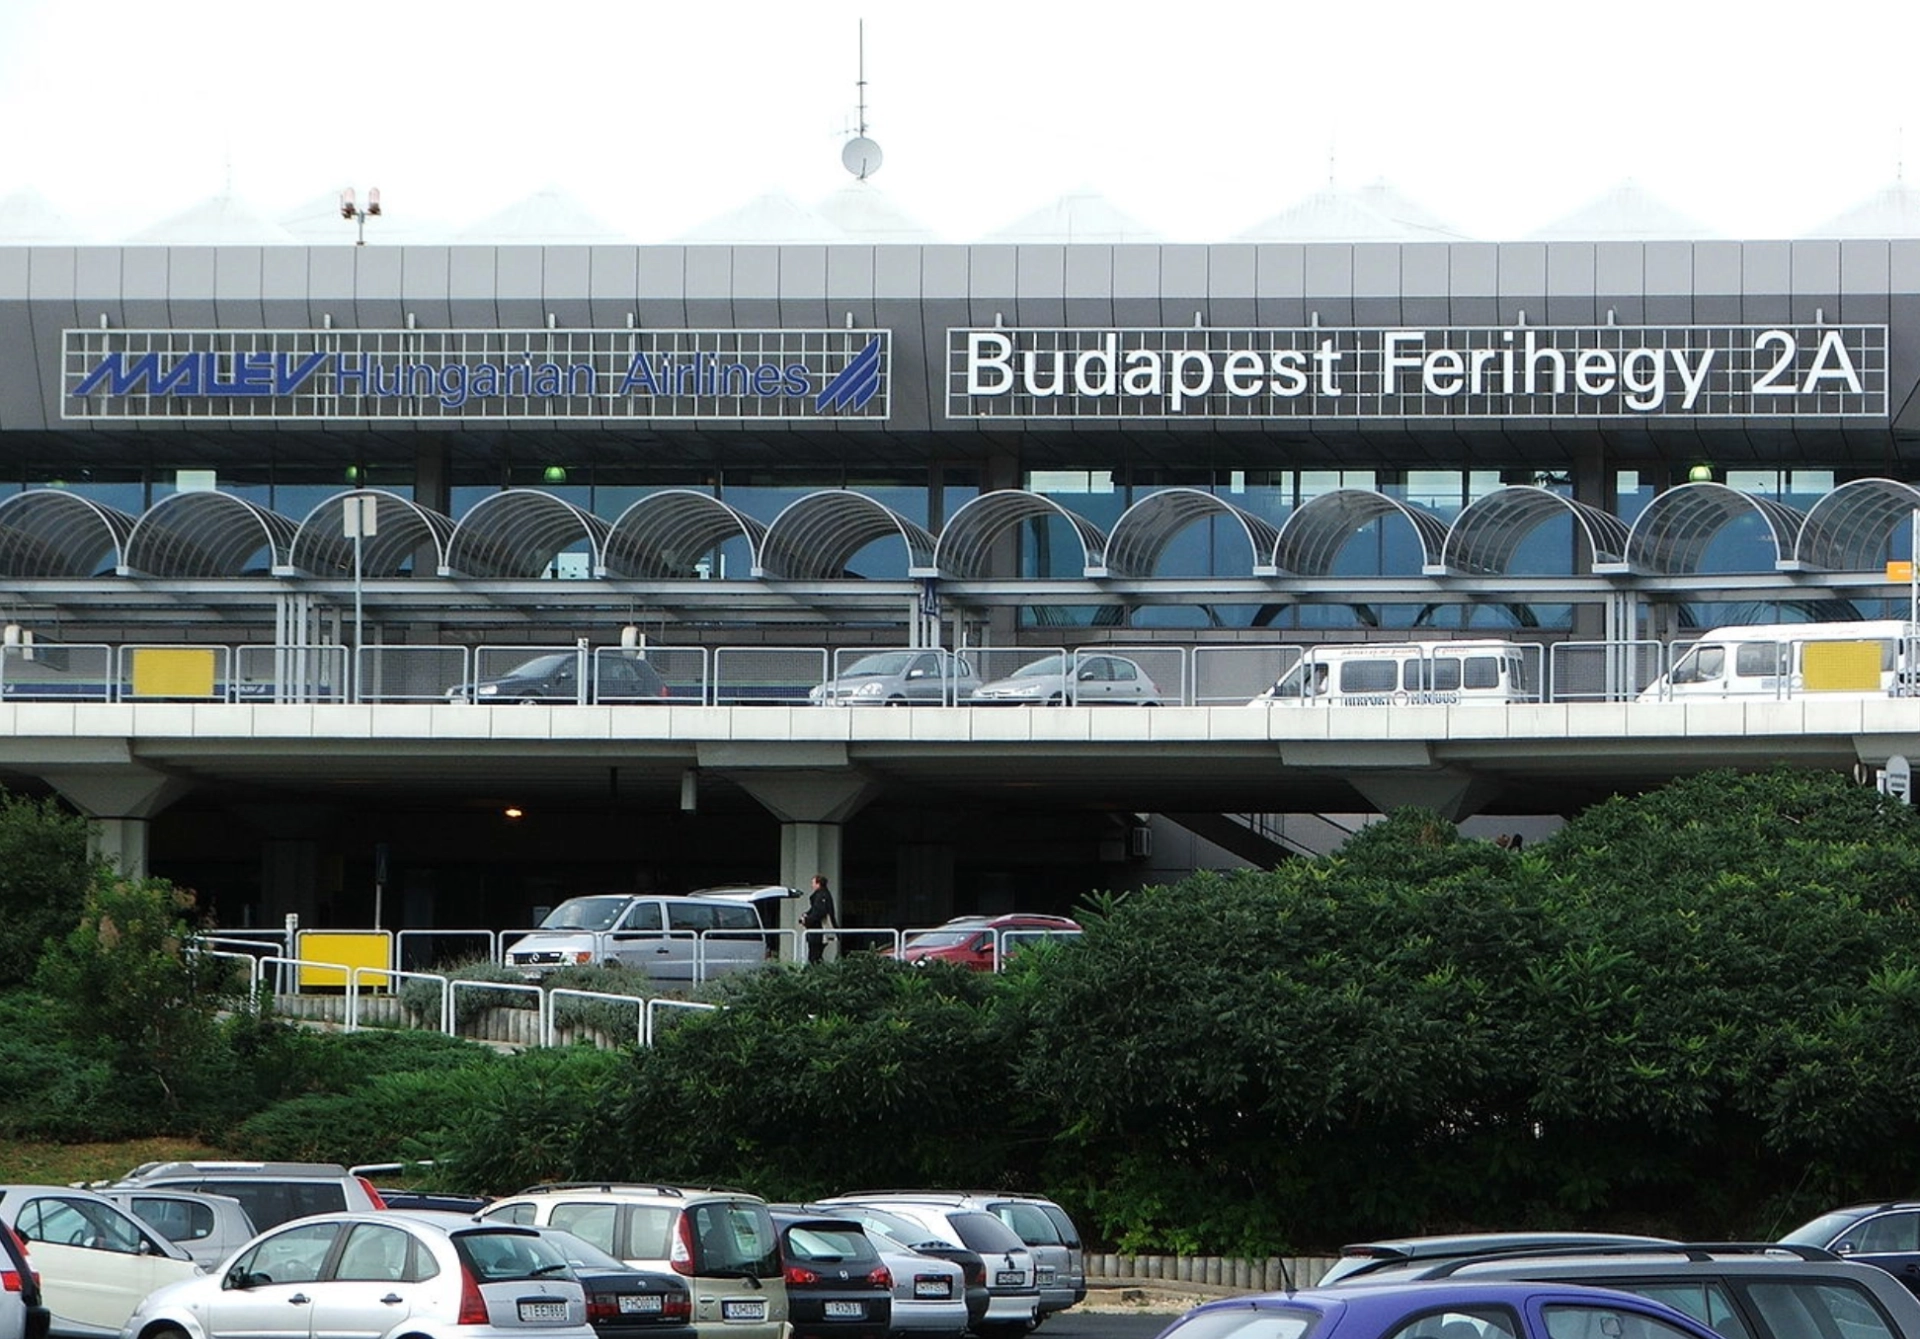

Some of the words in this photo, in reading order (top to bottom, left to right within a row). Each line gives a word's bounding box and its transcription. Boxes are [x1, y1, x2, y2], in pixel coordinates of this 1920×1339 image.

[336, 351, 596, 408] Hungarian
[620, 351, 811, 397] Airlines
[967, 332, 1342, 411] Budapest
[1382, 330, 1715, 410] Ferihegy
[1752, 330, 1862, 396] 2A
[1411, 693, 1457, 705] MNBUS
